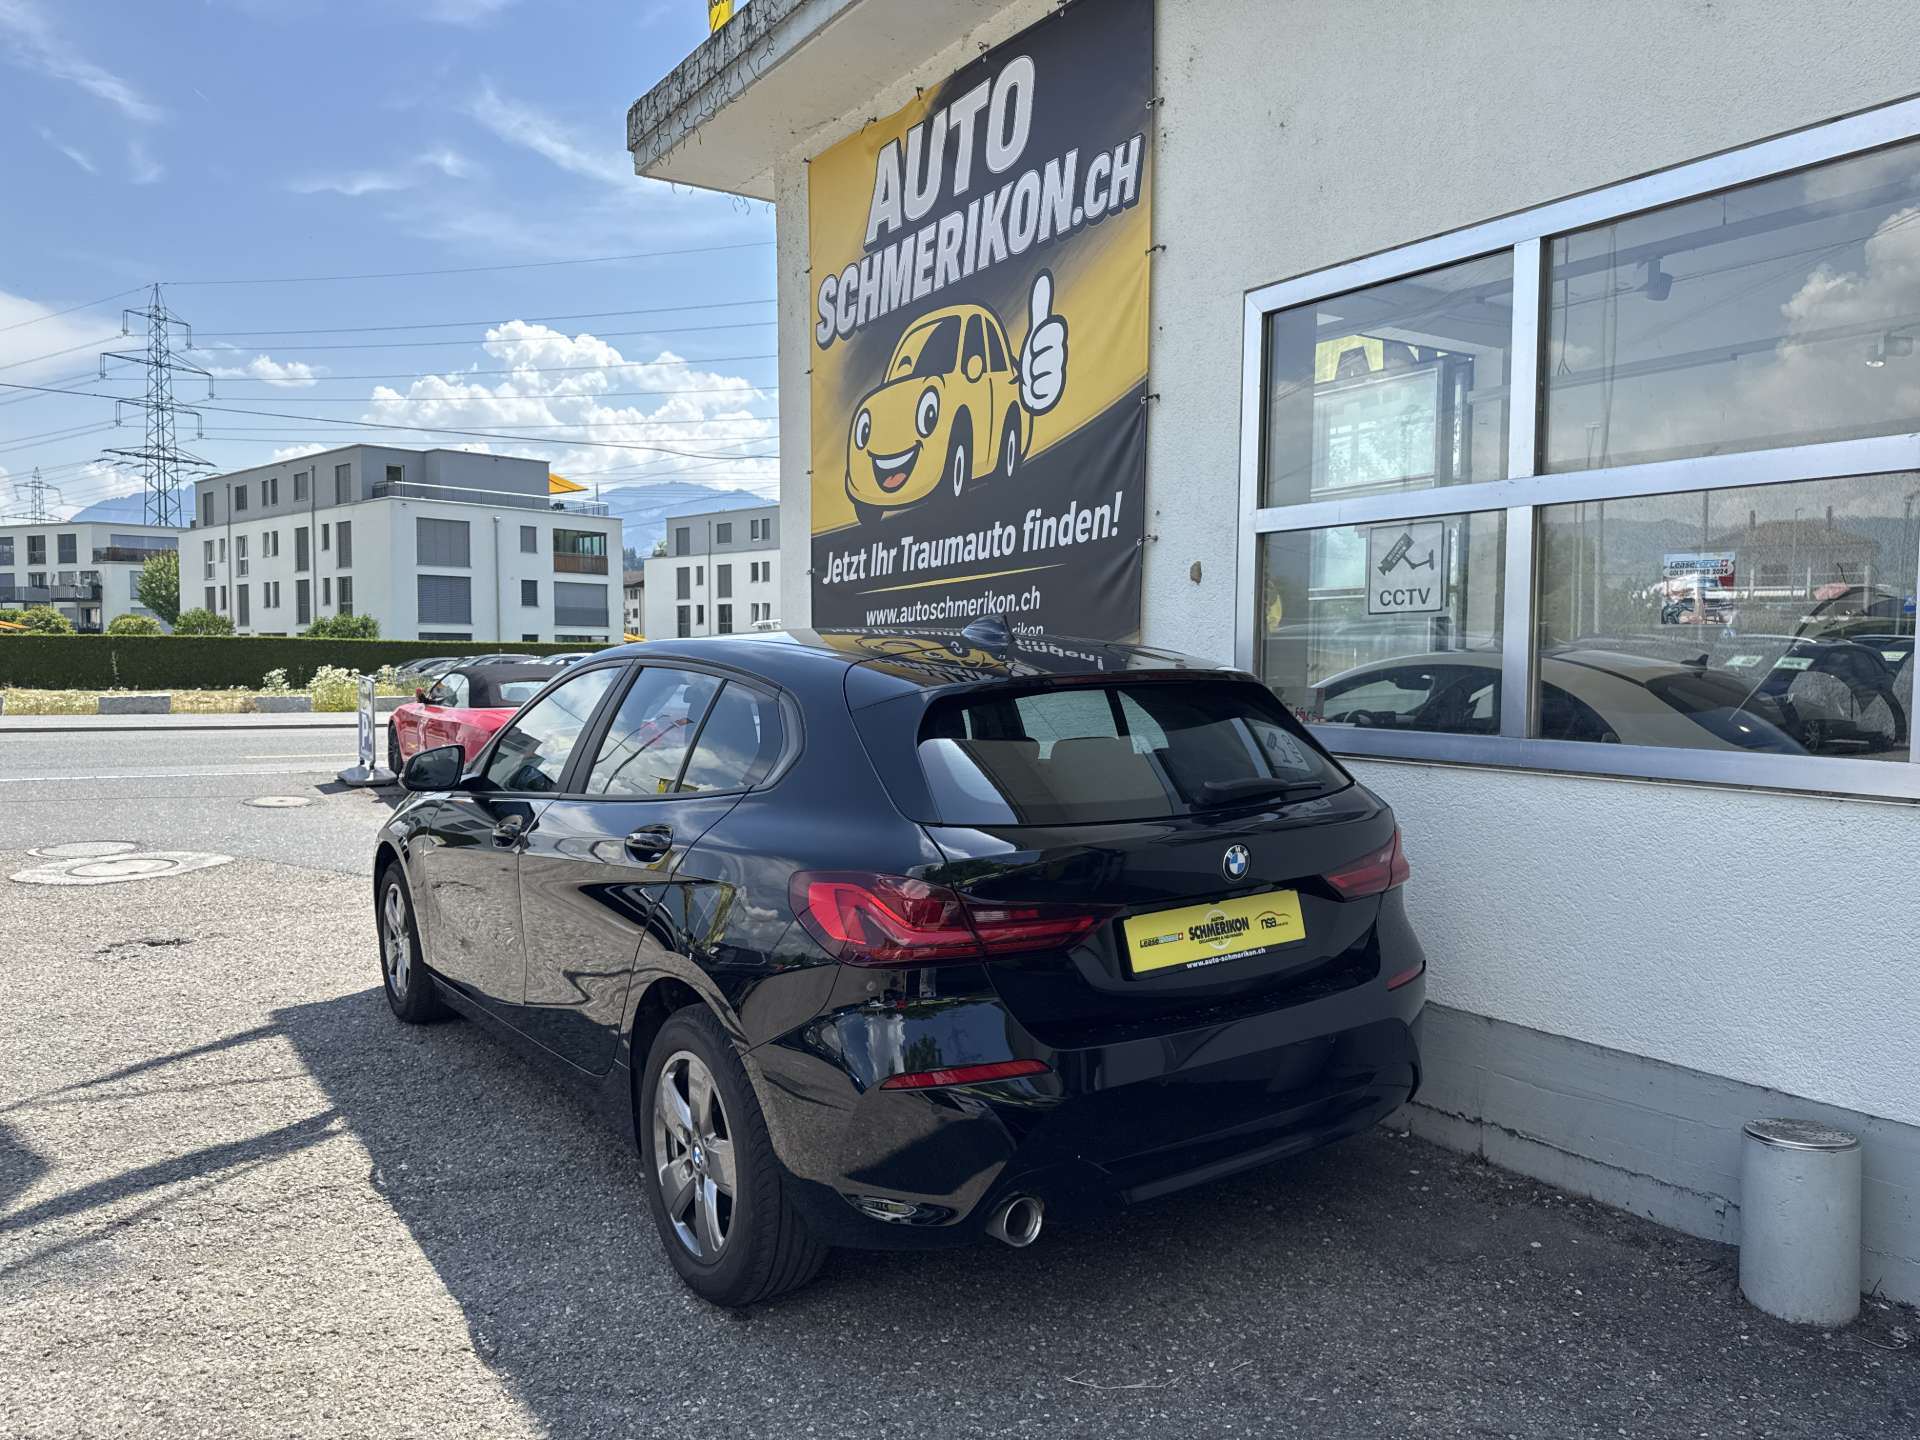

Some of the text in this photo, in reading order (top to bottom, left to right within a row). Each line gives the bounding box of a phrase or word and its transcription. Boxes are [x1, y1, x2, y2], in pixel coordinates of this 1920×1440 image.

[864, 55, 1035, 249] AUTO
[816, 134, 1143, 346] SCHMERIKON.CH
[822, 491, 1124, 585] Jetzt Ihr Traumauto finden!
[866, 585, 1041, 627] www.autoschmerikon.ch
[1379, 588, 1431, 606] CCTV
[1188, 917, 1250, 941] SCHMERIKON
